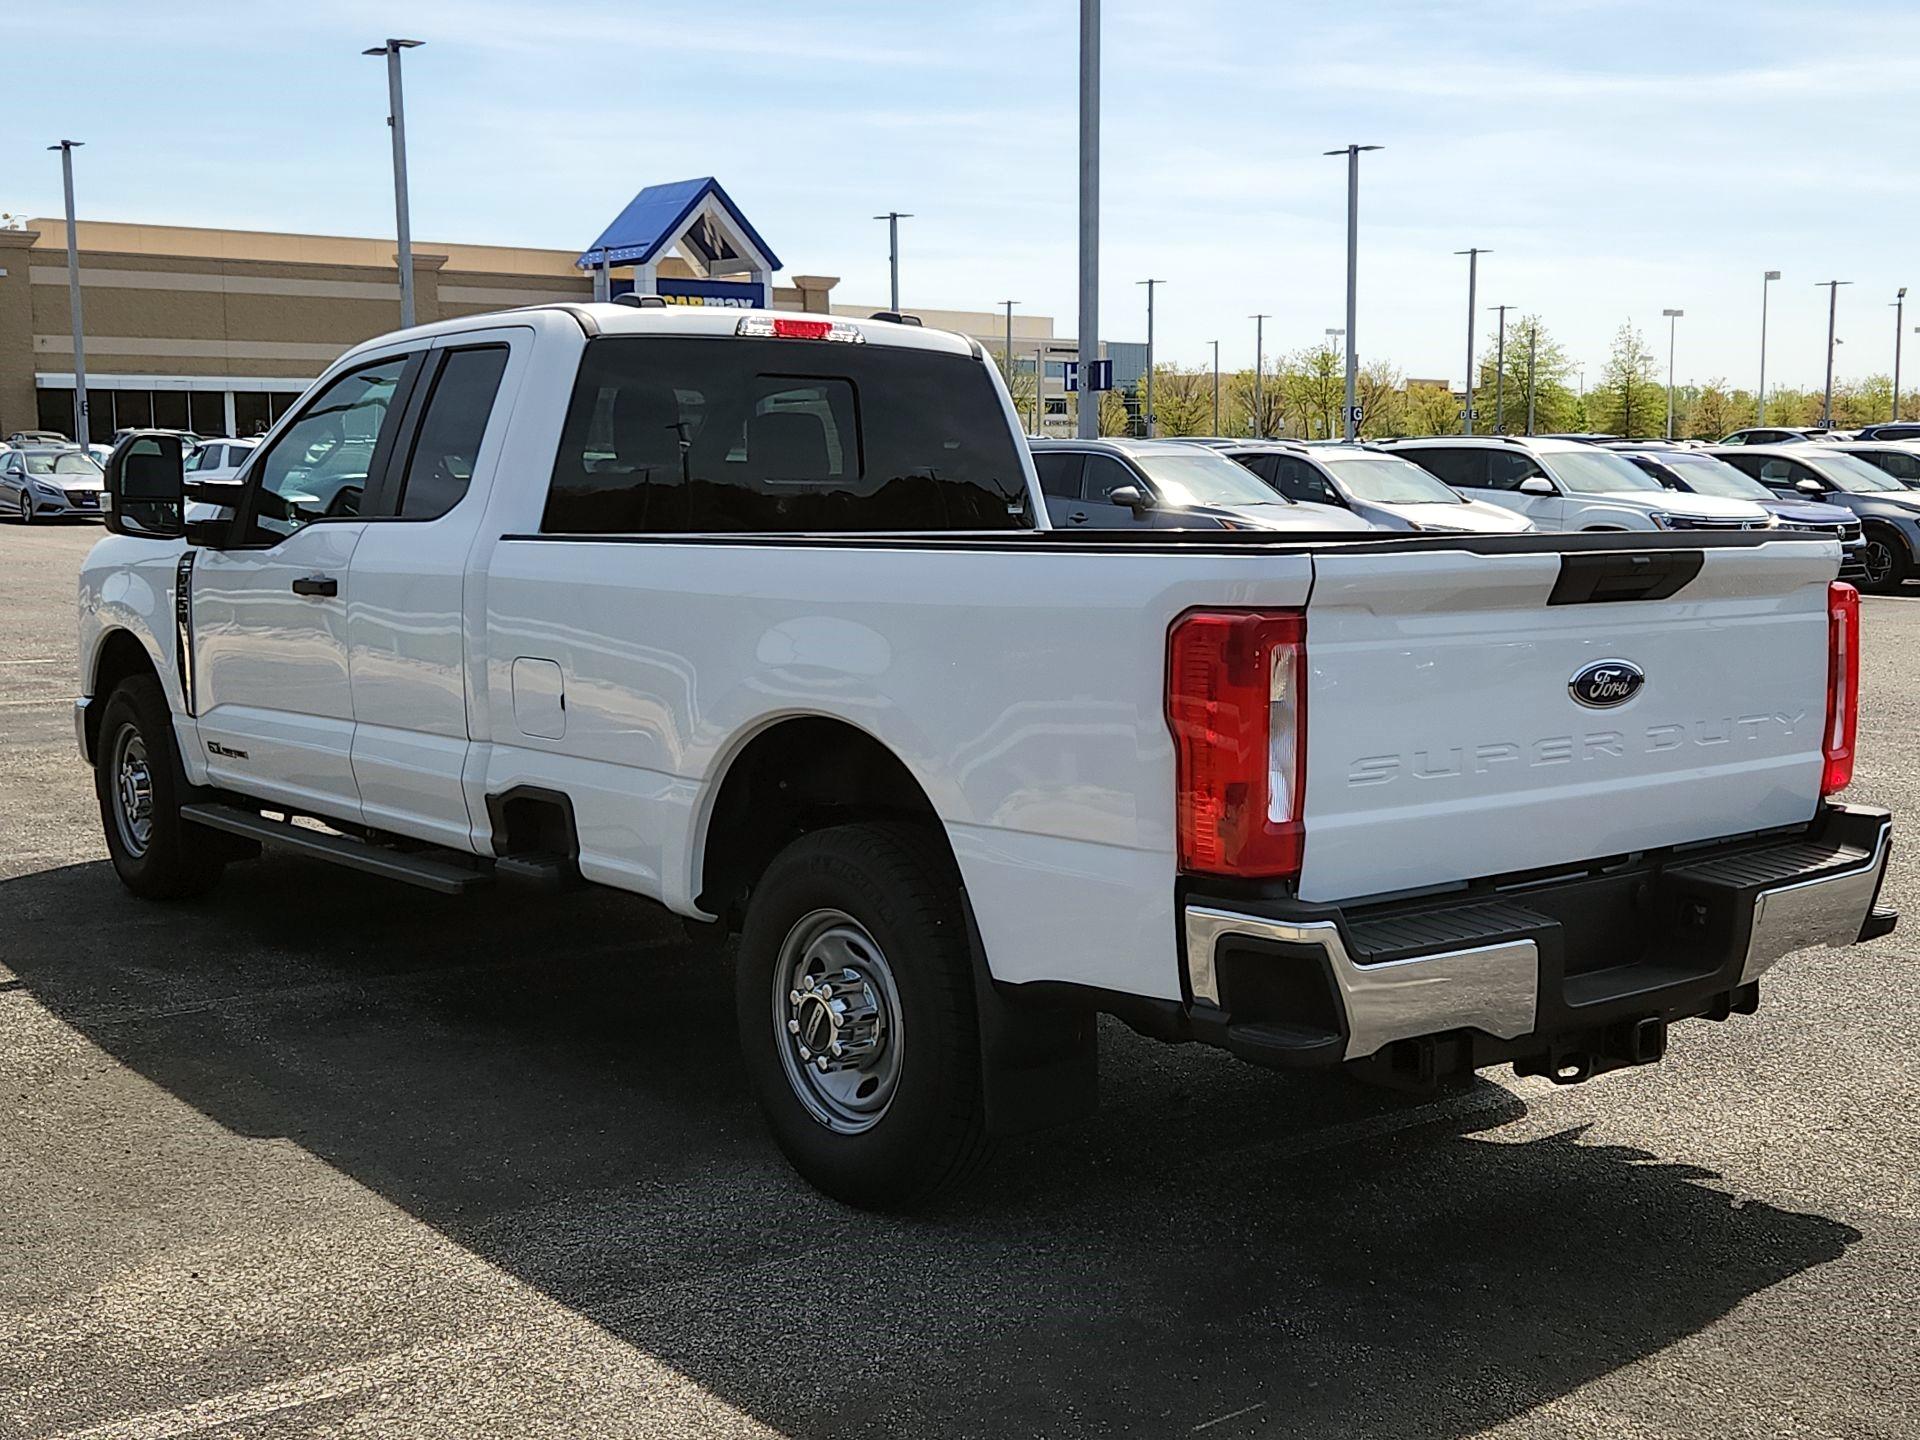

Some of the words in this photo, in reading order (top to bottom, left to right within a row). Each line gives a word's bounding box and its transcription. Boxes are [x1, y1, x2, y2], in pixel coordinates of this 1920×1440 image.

[1066, 363, 1079, 391] H
[1353, 407, 1363, 421] G
[1471, 410, 1478, 419] E
[1589, 669, 1631, 698] Ford
[1347, 731, 1625, 788] SUPER
[1643, 709, 1806, 754] DUTY
